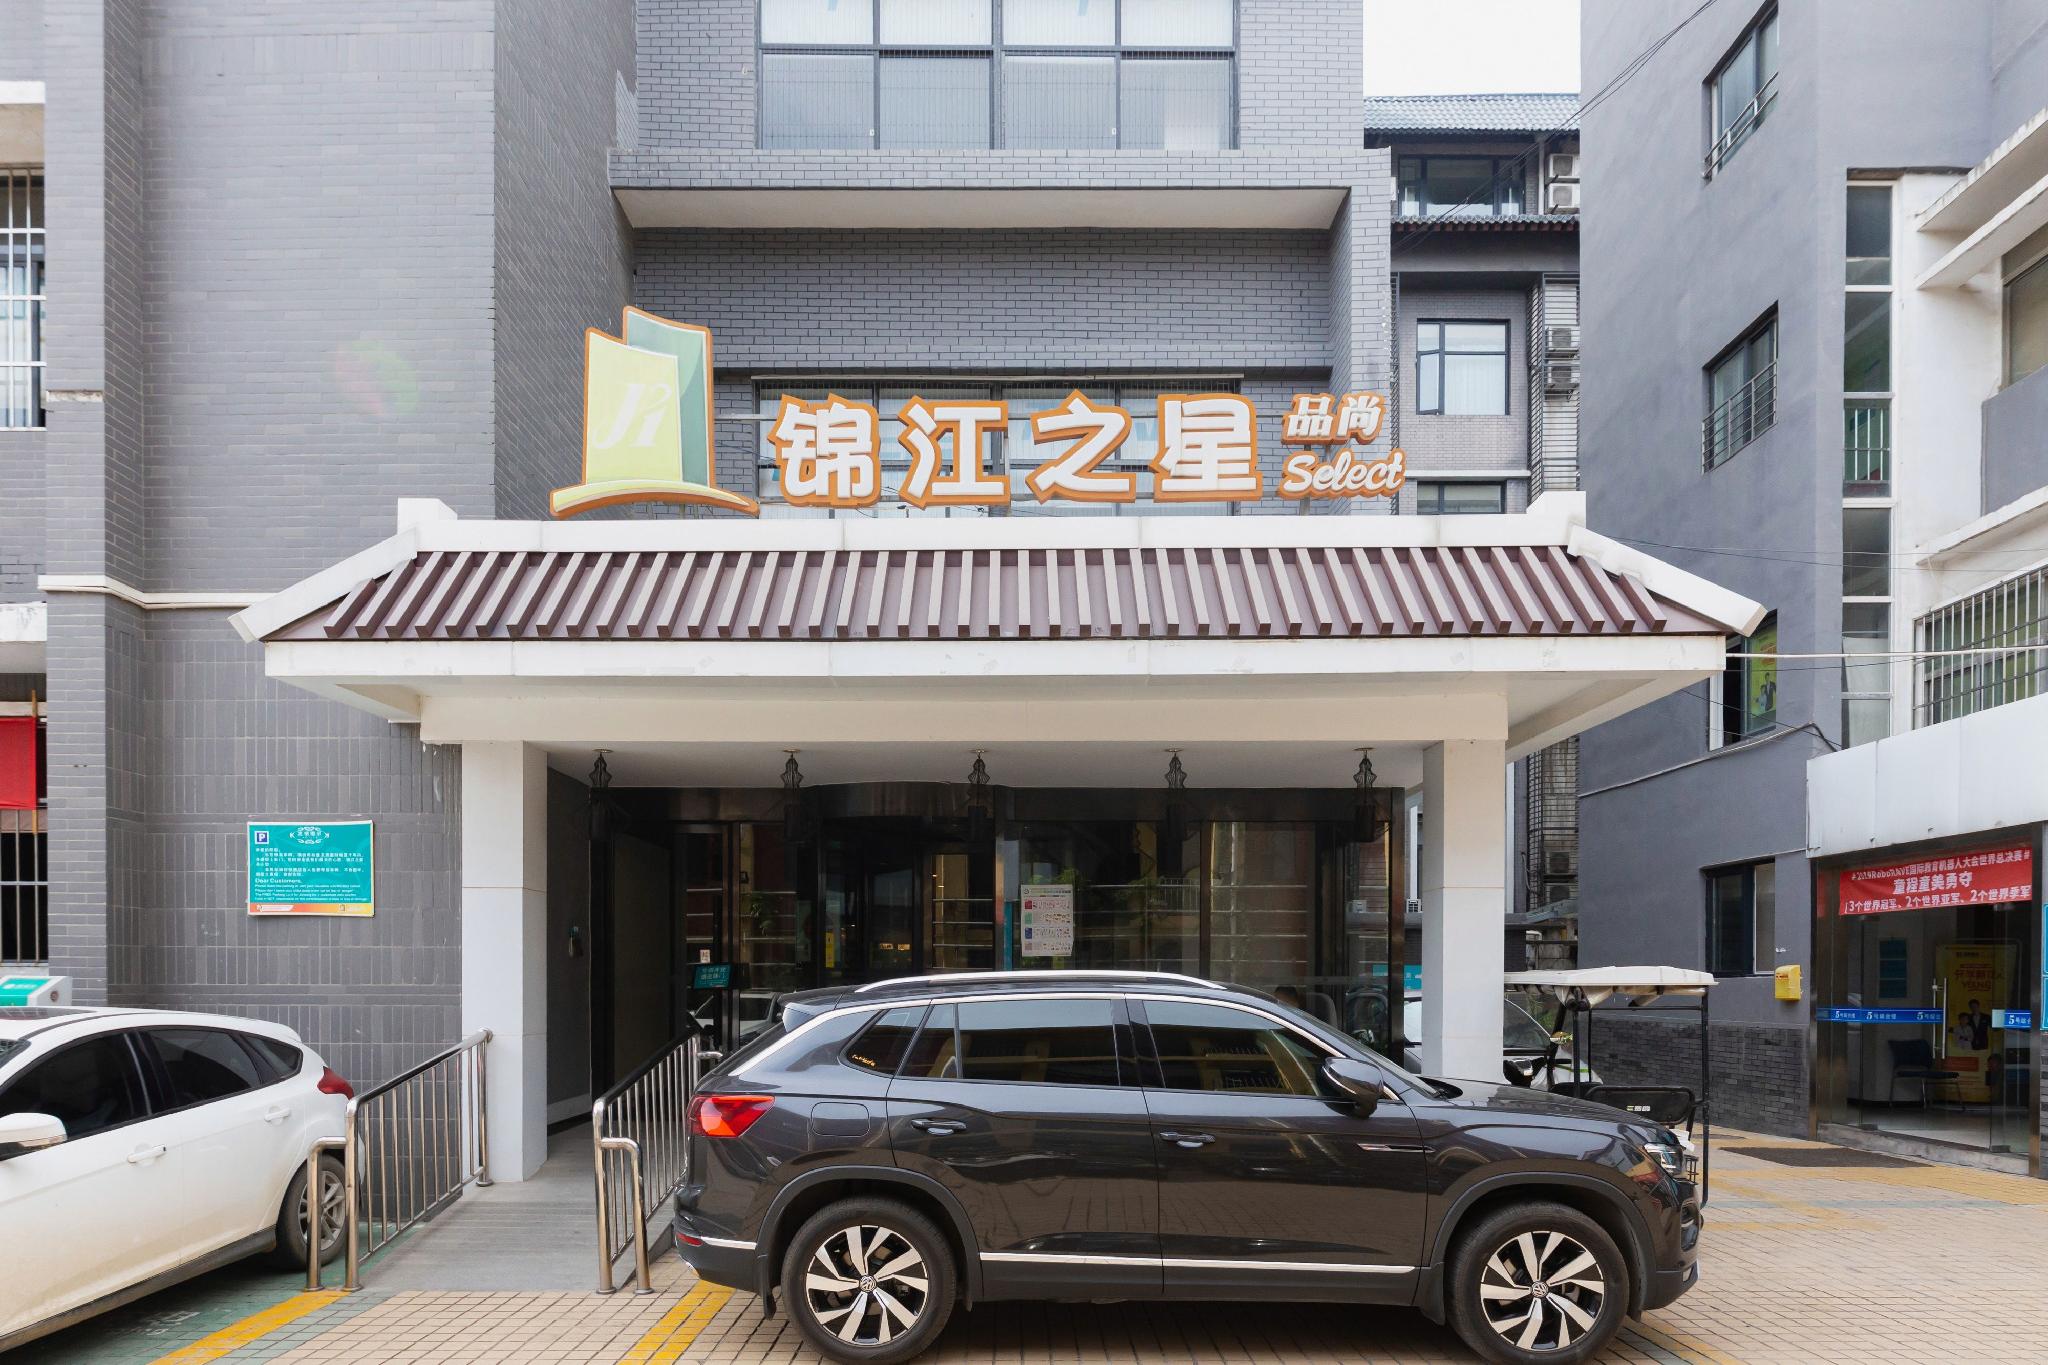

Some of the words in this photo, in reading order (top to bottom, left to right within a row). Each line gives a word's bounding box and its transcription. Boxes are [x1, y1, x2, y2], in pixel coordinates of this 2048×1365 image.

[1287, 395, 1382, 438] 品尚
[774, 396, 1260, 499] 锦江之星
[1283, 450, 1403, 492] Select
